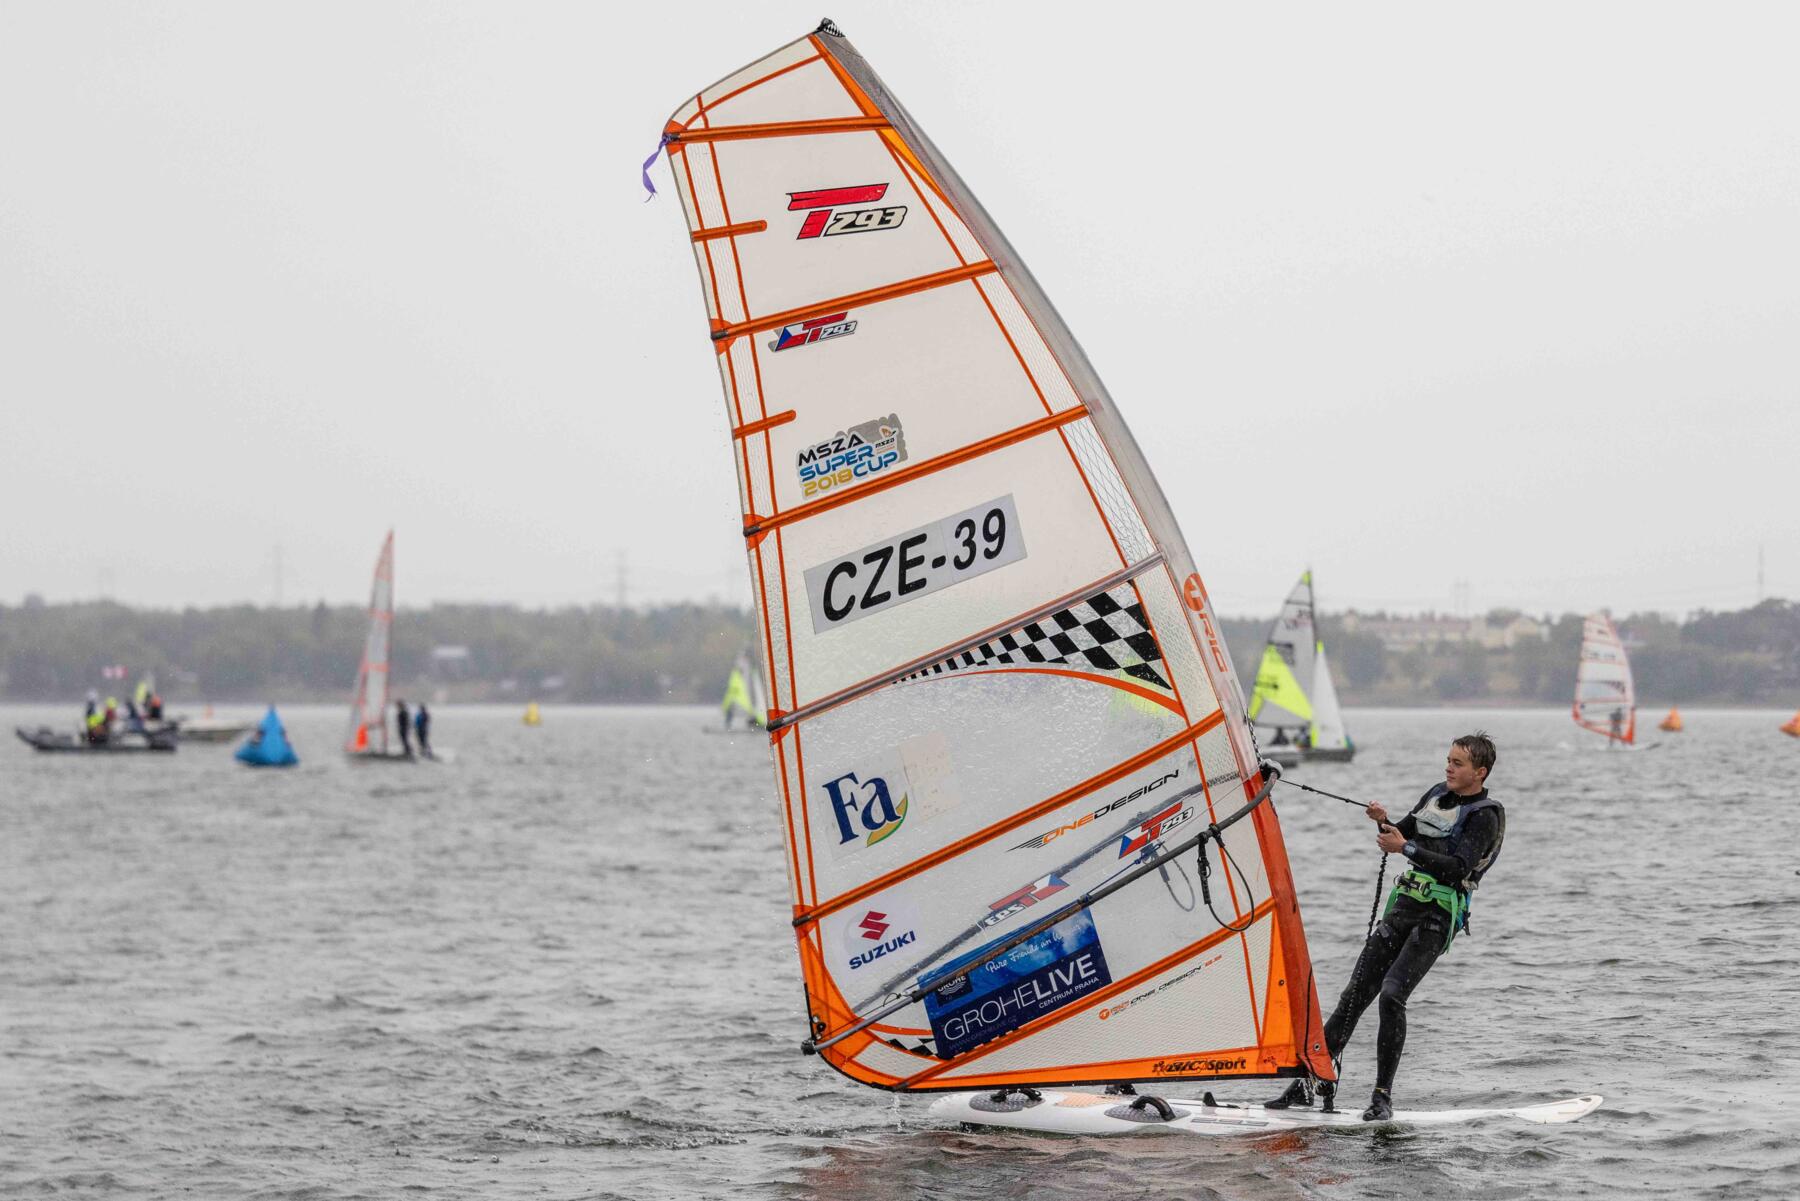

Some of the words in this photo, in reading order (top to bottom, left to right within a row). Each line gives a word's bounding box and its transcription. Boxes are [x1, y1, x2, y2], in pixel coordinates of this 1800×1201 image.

[798, 434, 864, 466] MSZA
[800, 445, 875, 482] SUPER
[803, 469, 854, 497] 2018
[853, 451, 899, 477] CUP
[823, 508, 1006, 622] CZE-39
[822, 772, 901, 845] Fa
[849, 930, 917, 970] SUZUKI
[985, 960, 1008, 973] Pure
[943, 953, 1097, 1041] GROHELIVE
[1039, 990, 1073, 1009] CENTRUM
[1074, 977, 1100, 992] PRAHA
[1131, 989, 1156, 1004] ONE
[1158, 965, 1202, 990] DESIGN
